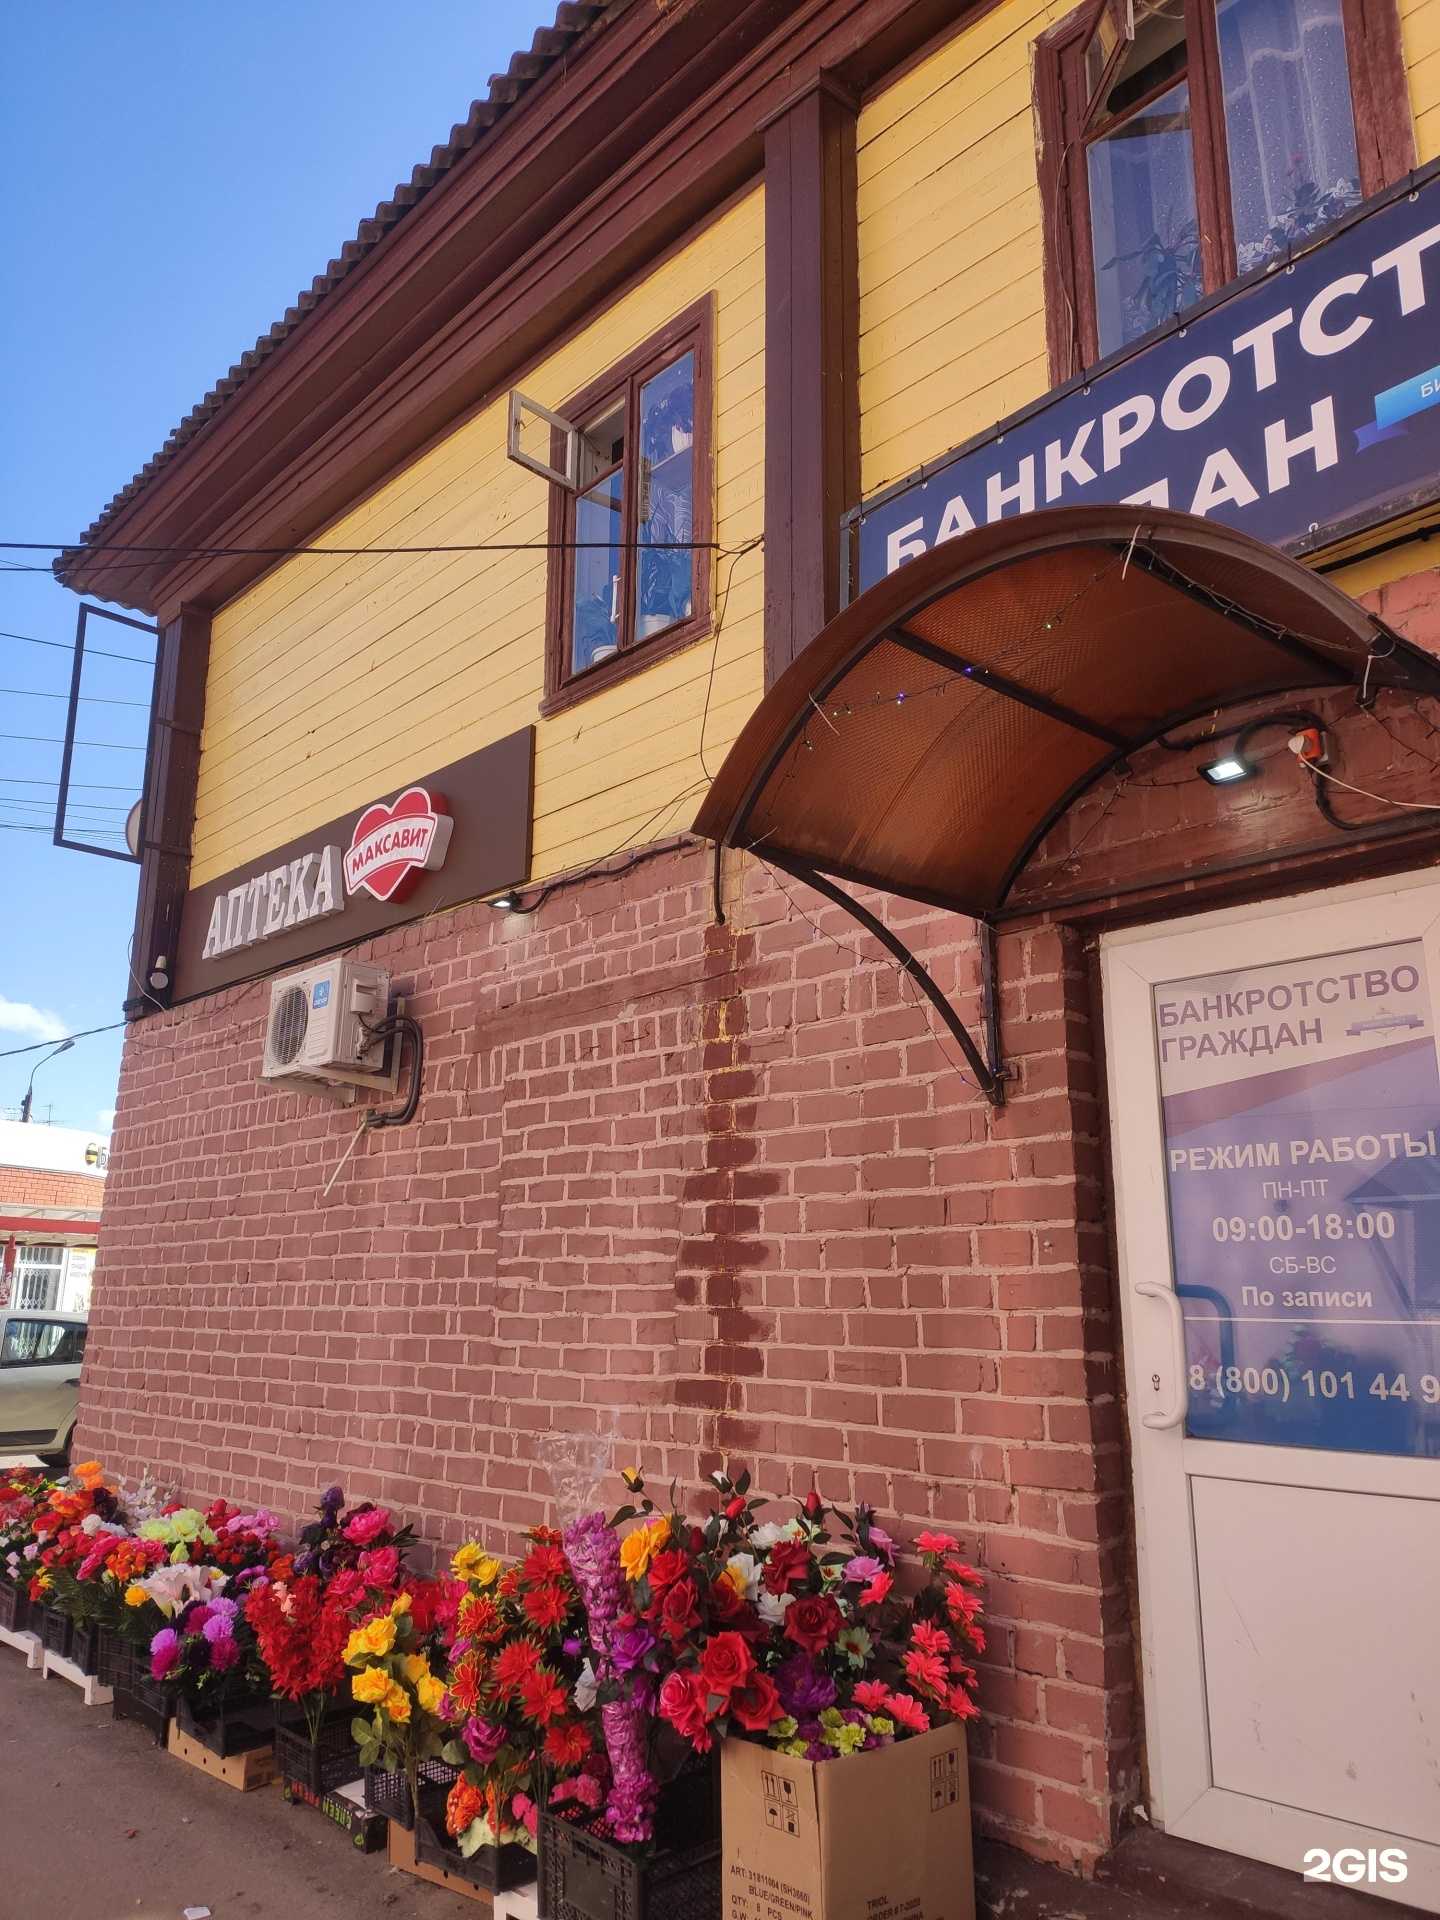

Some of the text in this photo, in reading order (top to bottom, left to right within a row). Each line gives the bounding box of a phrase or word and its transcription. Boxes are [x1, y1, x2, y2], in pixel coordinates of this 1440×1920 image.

[352, 828, 429, 874] МАКСАВИТ
[202, 845, 345, 960] АПТЕКА
[1159, 965, 1419, 1028] БАНКРОТСТВО
[1160, 1017, 1323, 1063] ГРАЖДАН
[1170, 1130, 1438, 1172] РЕЖИМ РАБОТЫ
[1262, 1179, 1328, 1200] ПН-ПТ
[1212, 1211, 1395, 1242] 09:00-18:00
[1269, 1256, 1337, 1274] СБ-ВС
[1241, 1286, 1373, 1308] По записи
[1190, 1364, 1206, 1391] 8
[1216, 1365, 1290, 1402] (800)
[1301, 1370, 1355, 1399] 101
[1368, 1372, 1410, 1401] 44
